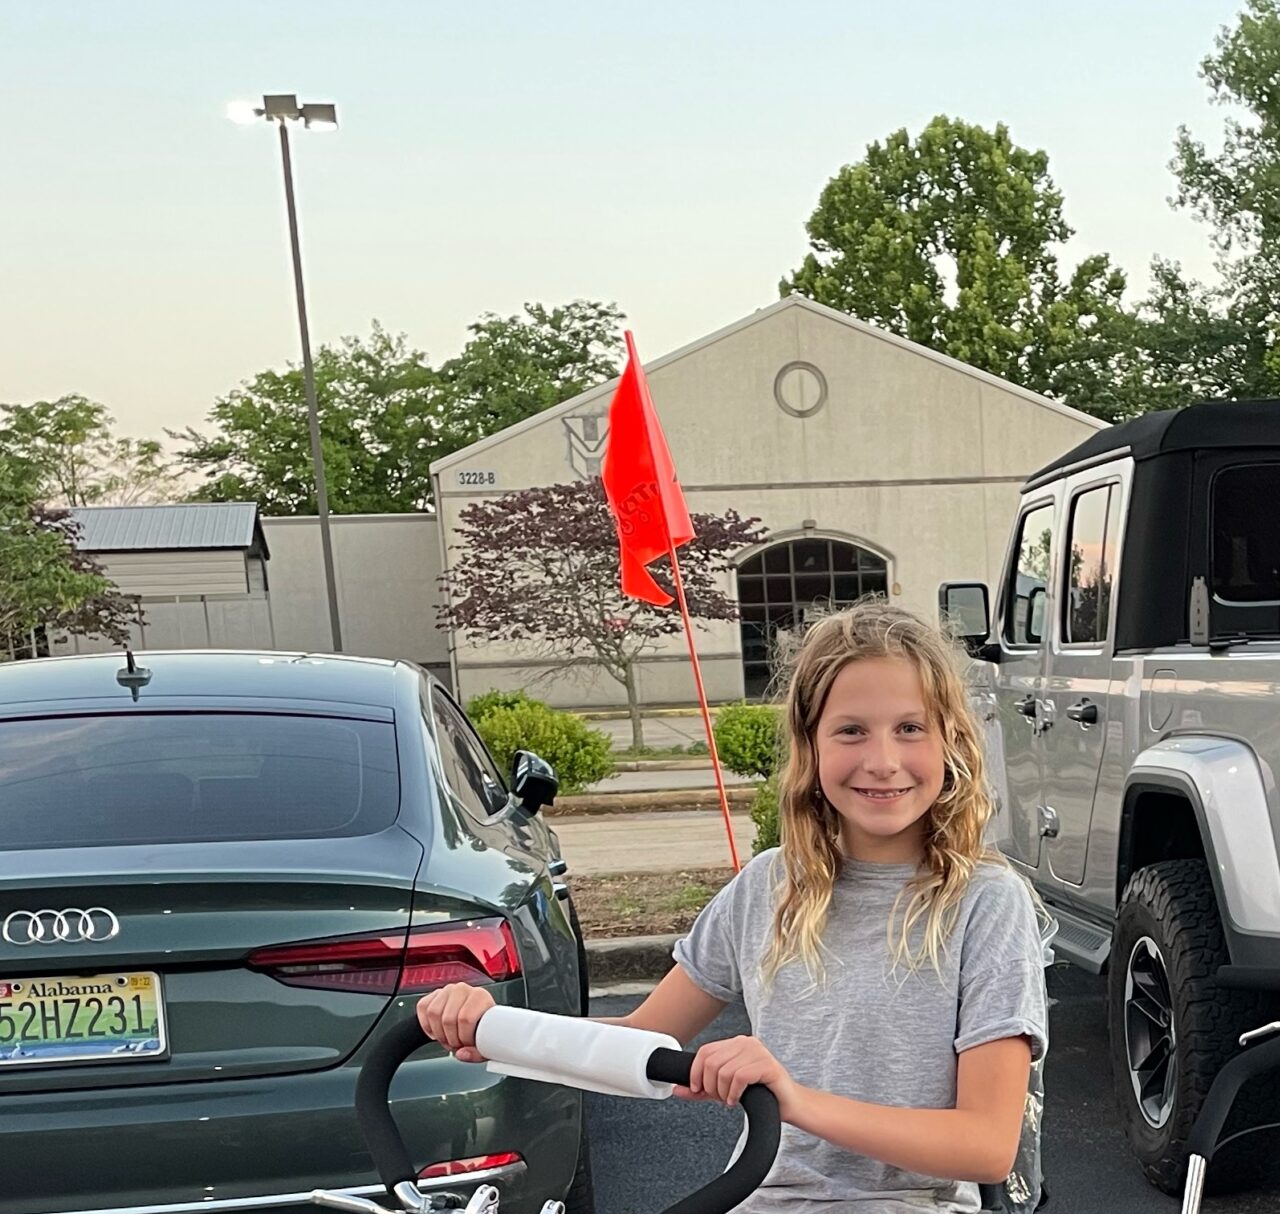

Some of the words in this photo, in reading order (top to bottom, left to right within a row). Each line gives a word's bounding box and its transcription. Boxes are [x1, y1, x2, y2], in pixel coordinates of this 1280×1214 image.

[459, 472, 495, 485] 3228-B
[27, 981, 113, 998] Alabama
[0, 994, 150, 1042] 52HZ231
